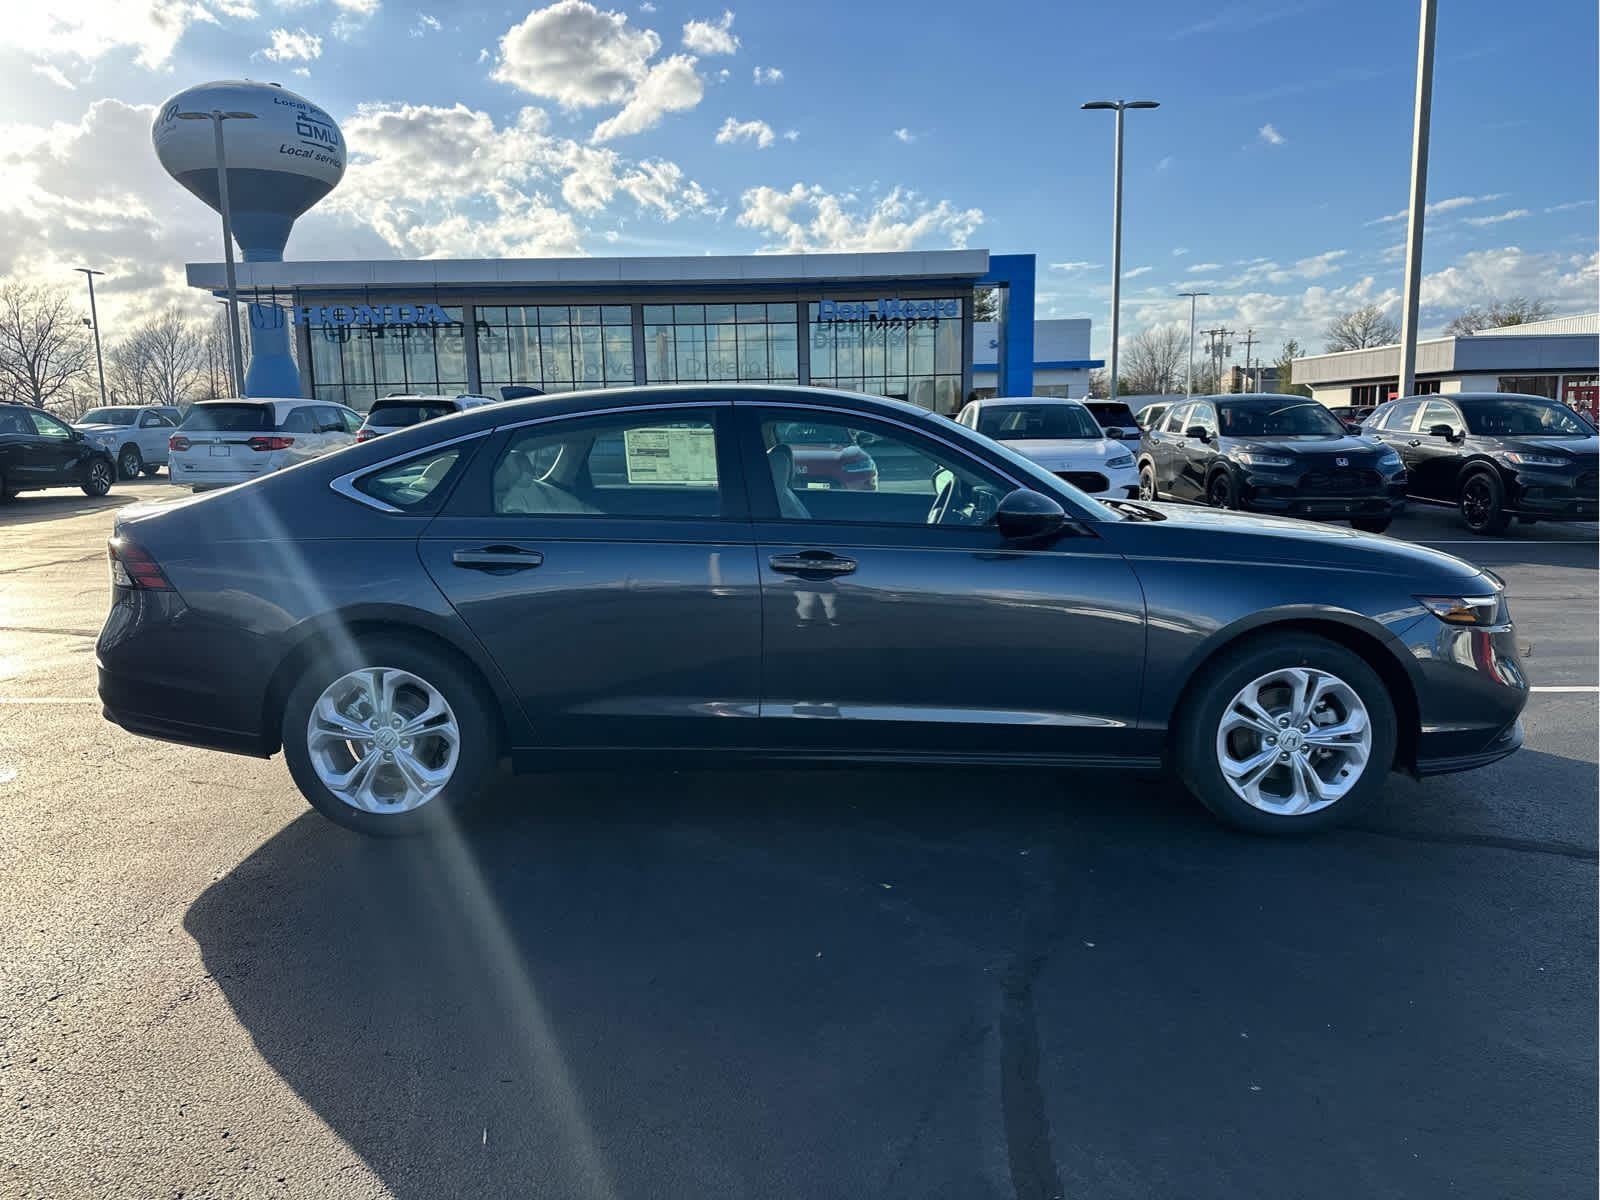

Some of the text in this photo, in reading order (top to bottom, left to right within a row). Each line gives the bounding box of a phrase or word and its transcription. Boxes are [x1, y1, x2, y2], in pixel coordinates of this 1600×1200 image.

[296, 122, 338, 145] OMU
[280, 144, 314, 158] Local
[294, 303, 451, 325] HONDA
[820, 297, 958, 320] Don Moore
